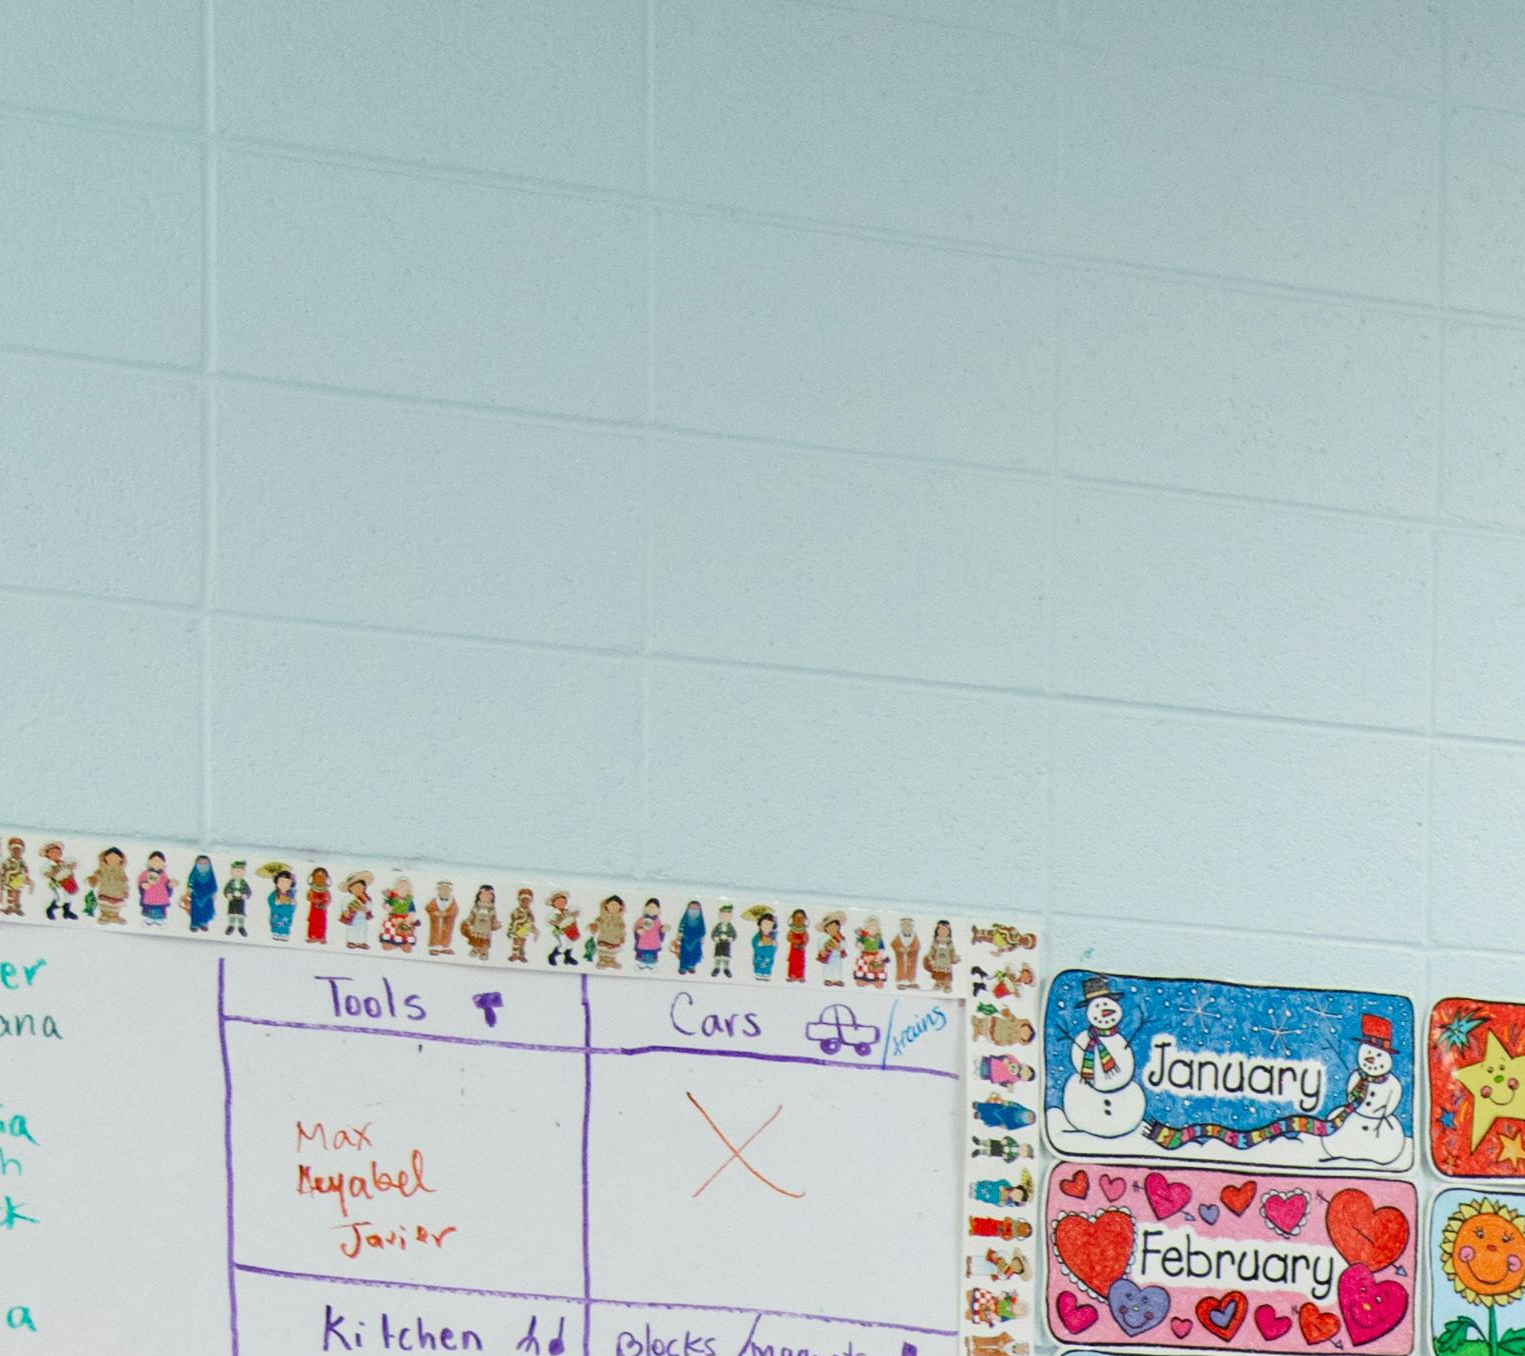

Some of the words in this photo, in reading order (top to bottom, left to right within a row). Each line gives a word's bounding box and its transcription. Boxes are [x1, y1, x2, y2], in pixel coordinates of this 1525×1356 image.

[314, 976, 426, 1021] Tools
[670, 992, 761, 1037] Cars
[1147, 1042, 1326, 1110] January
[296, 1121, 374, 1153] Max
[330, 1222, 459, 1260] Javier
[1142, 1230, 1336, 1297] February
[323, 1305, 483, 1351] Kitchen
